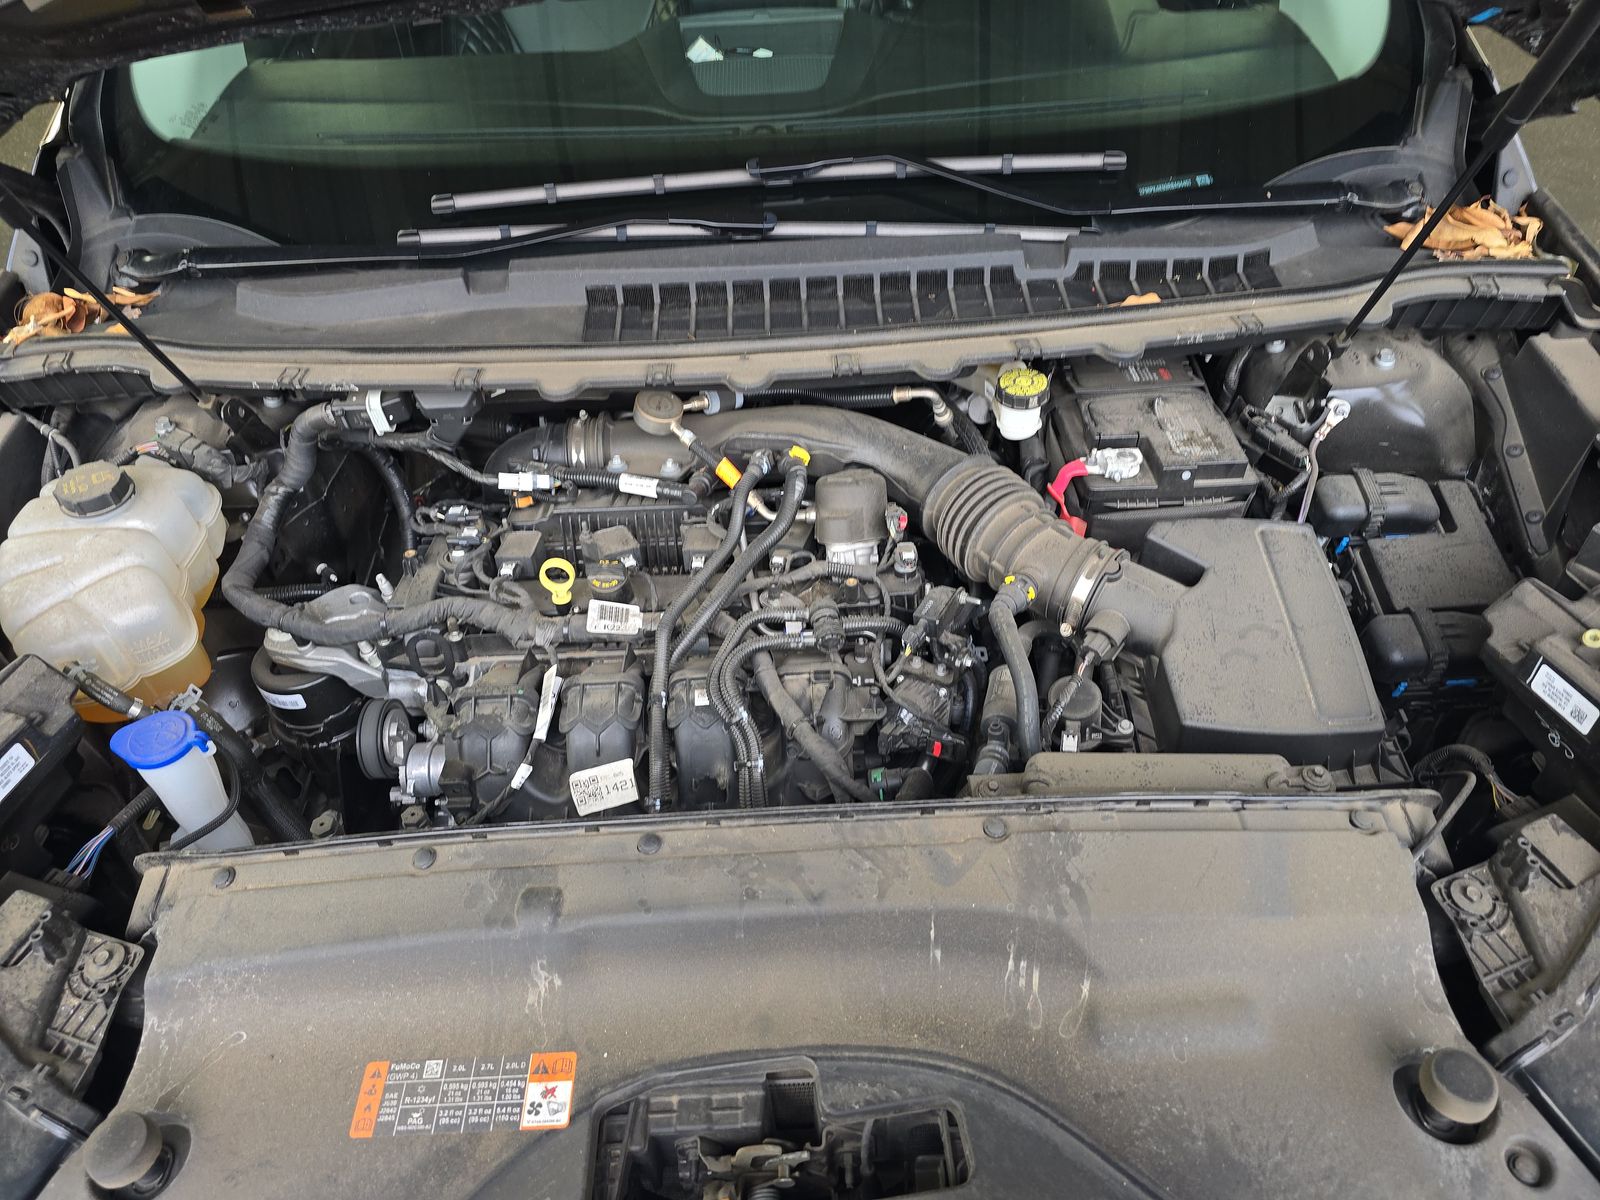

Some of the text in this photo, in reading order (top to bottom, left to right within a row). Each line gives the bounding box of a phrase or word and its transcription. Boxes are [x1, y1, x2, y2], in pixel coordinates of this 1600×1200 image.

[605, 778, 634, 795] 1421
[452, 1064, 466, 1072] 2.0L
[520, 1061, 526, 1069] D
[404, 1095, 436, 1105] R-1234yf
[407, 1117, 424, 1125] PAG
